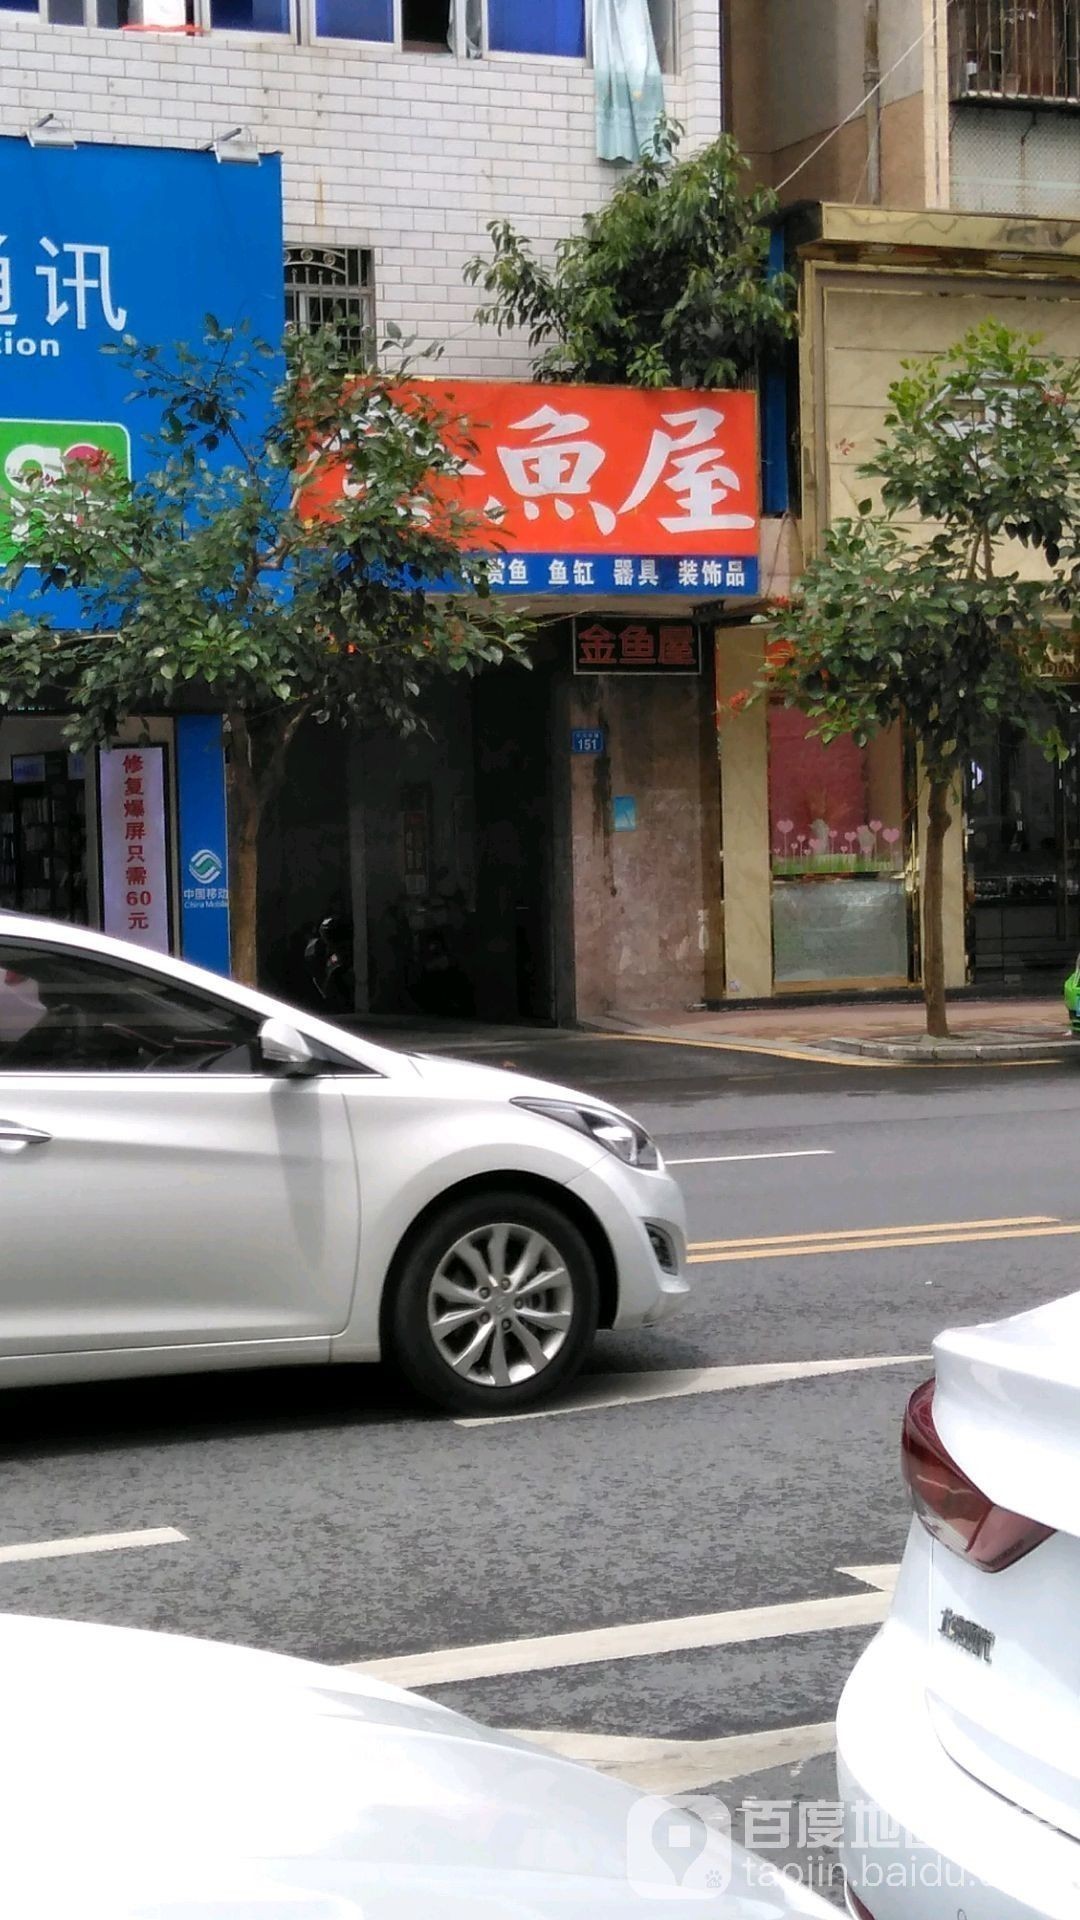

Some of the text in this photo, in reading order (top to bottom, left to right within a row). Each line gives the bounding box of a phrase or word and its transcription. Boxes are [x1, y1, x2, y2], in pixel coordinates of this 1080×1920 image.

[0, 234, 127, 332] 讯
[0, 330, 60, 357] ion
[548, 559, 595, 586] 鱼缸
[613, 559, 660, 587] 器具
[678, 560, 746, 588] 装饰品
[577, 623, 697, 665] 金鱼屋
[577, 738, 597, 751] 151
[183, 888, 229, 900] 中国移动
